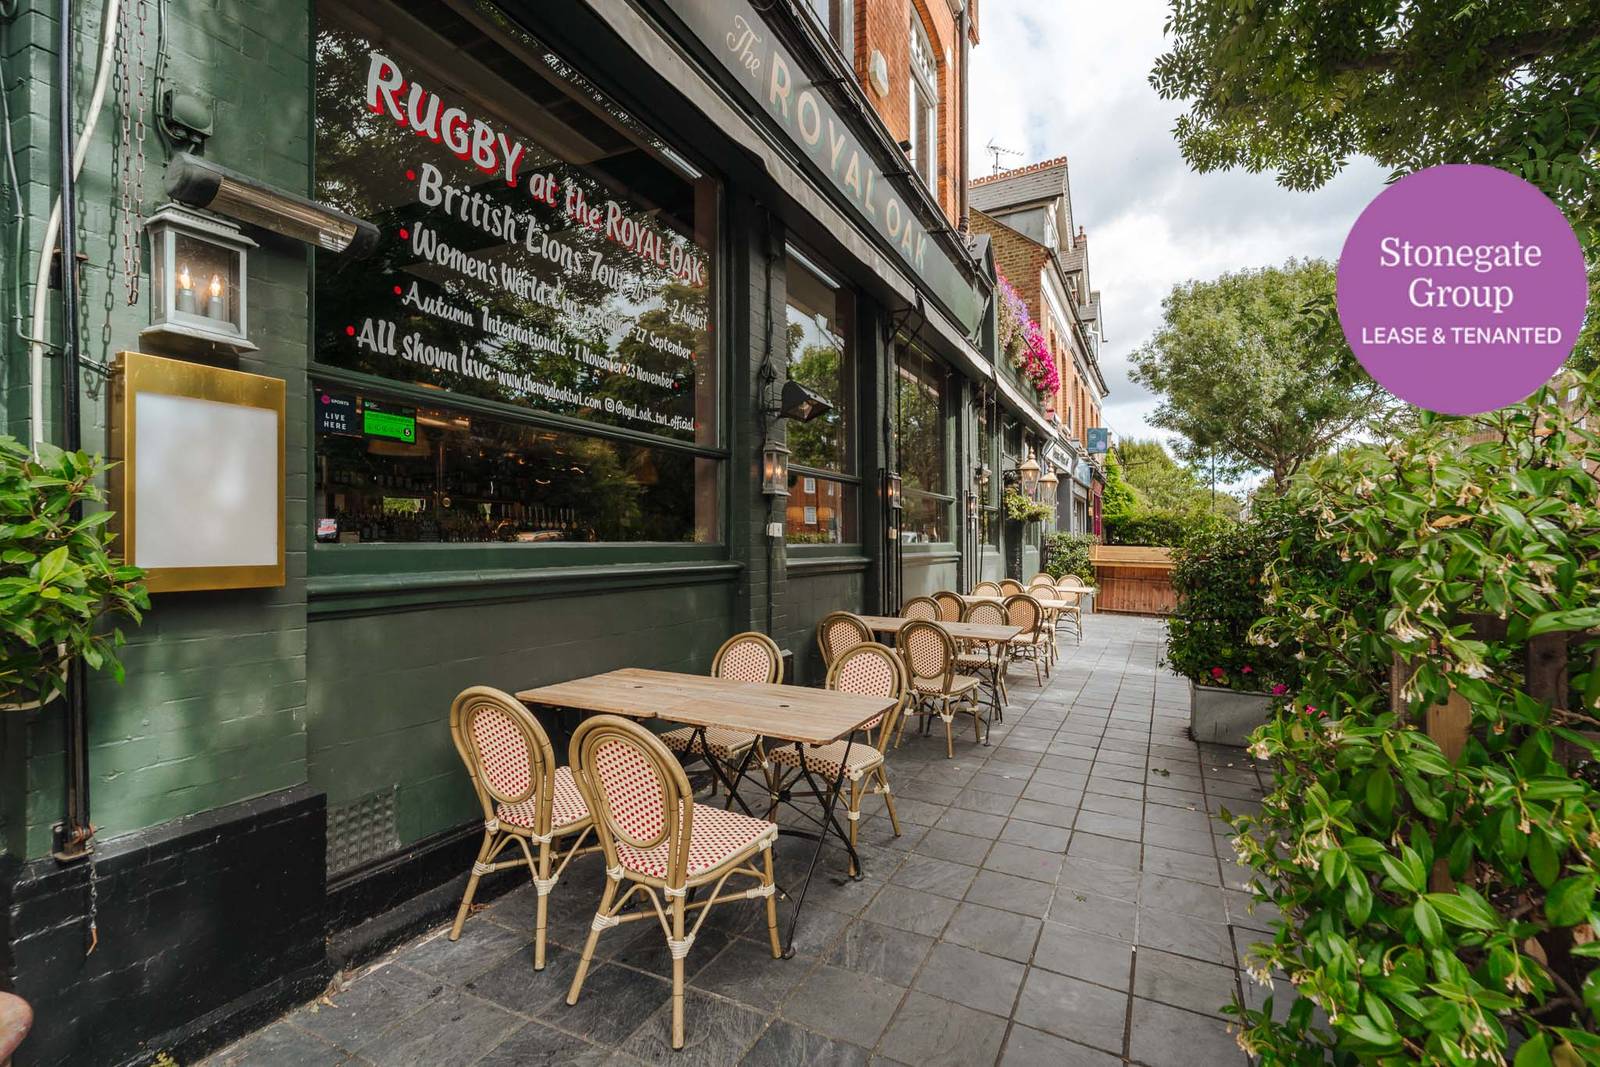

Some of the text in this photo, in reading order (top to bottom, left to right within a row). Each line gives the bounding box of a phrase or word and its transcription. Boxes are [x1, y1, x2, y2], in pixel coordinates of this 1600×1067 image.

[366, 52, 704, 288] RUGBY at the ROYAL OAK
[726, 14, 928, 271] The ROYAL OAK
[412, 221, 498, 286] Women's
[501, 261, 545, 306] World
[635, 326, 647, 343] 27
[649, 331, 692, 360] September
[419, 162, 517, 245] British
[526, 214, 583, 274] Lions
[672, 298, 680, 319] 2
[680, 304, 708, 331] August
[356, 317, 398, 356] All
[401, 332, 459, 374] shown
[402, 280, 474, 327] Autumn
[574, 343, 582, 361] 1
[582, 345, 623, 374] November
[626, 362, 636, 379] 23
[636, 365, 674, 390] November
[323, 420, 347, 430] HERE
[325, 411, 345, 422] LIVE
